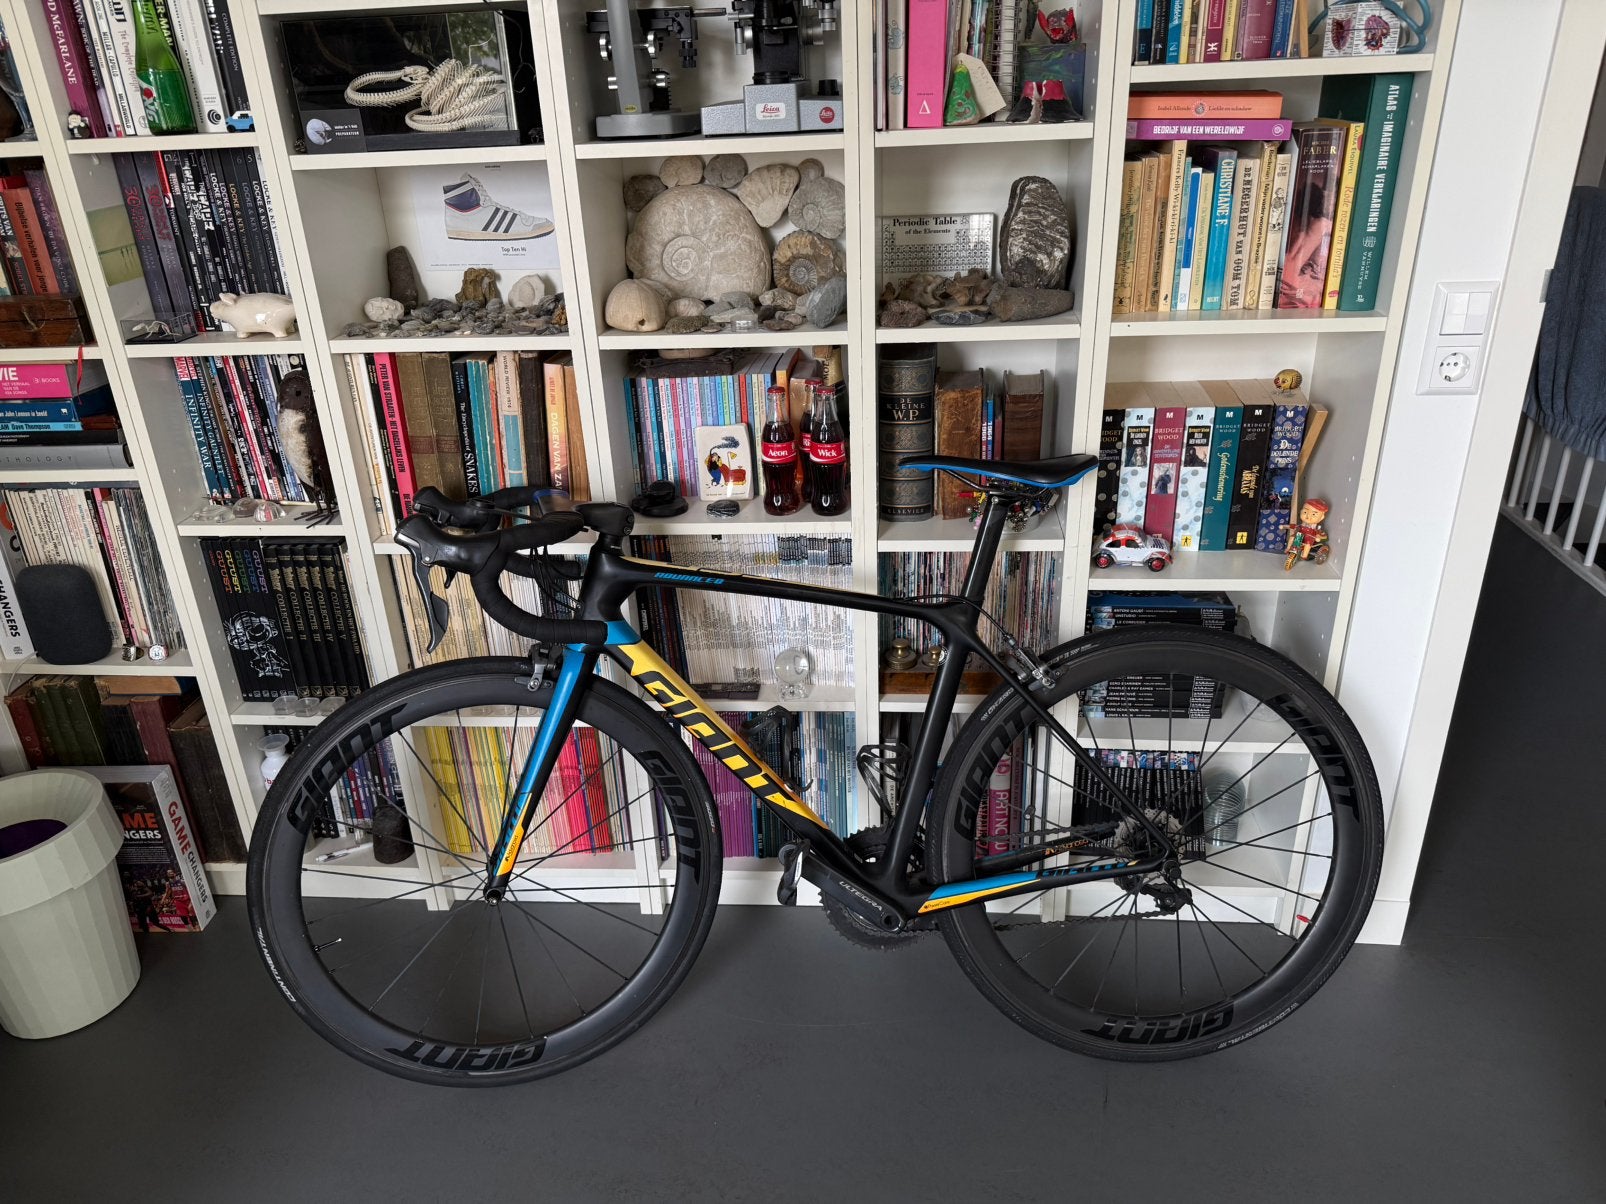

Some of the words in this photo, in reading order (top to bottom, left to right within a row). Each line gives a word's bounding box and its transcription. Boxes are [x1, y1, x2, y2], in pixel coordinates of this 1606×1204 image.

[49, 13, 79, 85] McFARLANE
[118, 29, 129, 41] The
[217, 12, 235, 45] COMPLETE
[227, 46, 240, 71] EDITION
[100, 31, 112, 51] MILLAR
[107, 55, 119, 78] CAPULLO
[119, 41, 136, 68] Complete
[116, 93, 133, 129] MILLARWORLD
[760, 104, 780, 113] Leica
[1385, 84, 1401, 112] ATLAS
[1153, 126, 1179, 134] BEDRIJF
[1180, 126, 1192, 134] VAN
[1192, 126, 1204, 134] EEN
[1205, 126, 1245, 134] WERELDWIJF
[1351, 125, 1361, 146] LAURA
[1303, 145, 1337, 154] FABER
[1376, 120, 1395, 172] IMAGINAIRE
[1175, 149, 1185, 174] Frances
[1244, 167, 1251, 178] DE
[35, 187, 43, 201] DAN
[209, 172, 221, 198] LOCKE
[218, 207, 227, 224] KEY
[1173, 175, 1181, 192] Kelly
[1215, 159, 1236, 217] CHRISTIANE
[1341, 185, 1355, 208] Rode
[14, 201, 30, 230] Bijbelse
[218, 182, 231, 208] LOCKE
[227, 217, 236, 233] KEY
[228, 182, 241, 209] LOCKE
[236, 218, 247, 235] KEY
[241, 182, 253, 207] LOCKE
[249, 216, 259, 233] KEY
[252, 180, 264, 206] LOCKE
[259, 215, 269, 232] KEY
[1236, 179, 1254, 238] NEGERHUT
[1365, 172, 1386, 233] VERKLARINGEN
[3, 220, 13, 237] VAN
[169, 209, 180, 236] TORMENT
[893, 217, 930, 227] Periodic
[932, 216, 958, 225] Table
[1215, 218, 1228, 229] F.
[1338, 209, 1350, 233] rozen
[24, 229, 39, 258] verhalen
[1235, 239, 1243, 255] VAN
[1337, 235, 1346, 246] en
[33, 259, 43, 274] voor
[1232, 258, 1243, 281] OOM
[1331, 247, 1346, 280] tortilla's
[1363, 251, 1373, 280] WILLEM
[37, 273, 50, 293] jonge
[1230, 283, 1241, 307] TOM
[378, 363, 389, 380] PETER
[501, 355, 509, 375] WORLD
[382, 381, 391, 391] VAN
[503, 375, 512, 394] REVIEW
[459, 401, 467, 412] The
[892, 409, 919, 421] W.P.
[24, 423, 51, 431] Thompson
[186, 394, 206, 444] INFINITY
[200, 446, 212, 468] WAR
[196, 392, 212, 431] INFINITY
[207, 432, 224, 474] GAUNTLET
[389, 420, 398, 430] HET
[457, 412, 473, 446] Encyclopedia
[548, 412, 562, 449] DAGEN
[390, 430, 404, 458] DAGELIJKS
[768, 449, 788, 457] Aeon
[818, 448, 837, 457] Wick
[396, 458, 407, 474] LEVEN
[461, 451, 482, 494] SNAKES
[552, 450, 563, 471] VAN
[1251, 464, 1259, 473] De
[1211, 451, 1232, 502] Godenschemering
[215, 549, 233, 594] GUUST
[223, 549, 242, 594] GUUST
[233, 550, 252, 595] GUUST
[242, 549, 260, 593] GUUST
[251, 549, 269, 595] GUUST
[654, 572, 725, 585] ADVANCED
[275, 592, 293, 633] COLLECTIE
[288, 591, 305, 631] COLLECTIE
[299, 633, 307, 641] II
[302, 590, 319, 631] COLLECTIE
[313, 632, 322, 643] III
[315, 590, 332, 631] COLLECTIE
[325, 633, 334, 643] IV
[328, 590, 345, 632] COLLECTIE
[632, 668, 794, 804] GIANT
[287, 703, 408, 834] GIANT
[1273, 693, 1360, 823] GIANT
[638, 750, 700, 884] GIANT
[996, 792, 1008, 816] ART
[122, 813, 158, 829] ME
[165, 800, 193, 856] GAME
[186, 851, 209, 904] CHANGERS
[839, 881, 882, 912] ULTEGRA
[257, 927, 297, 1002] CONTINENTAL
[1080, 1001, 1235, 1045] GIANT
[384, 1038, 547, 1071] GIANT
